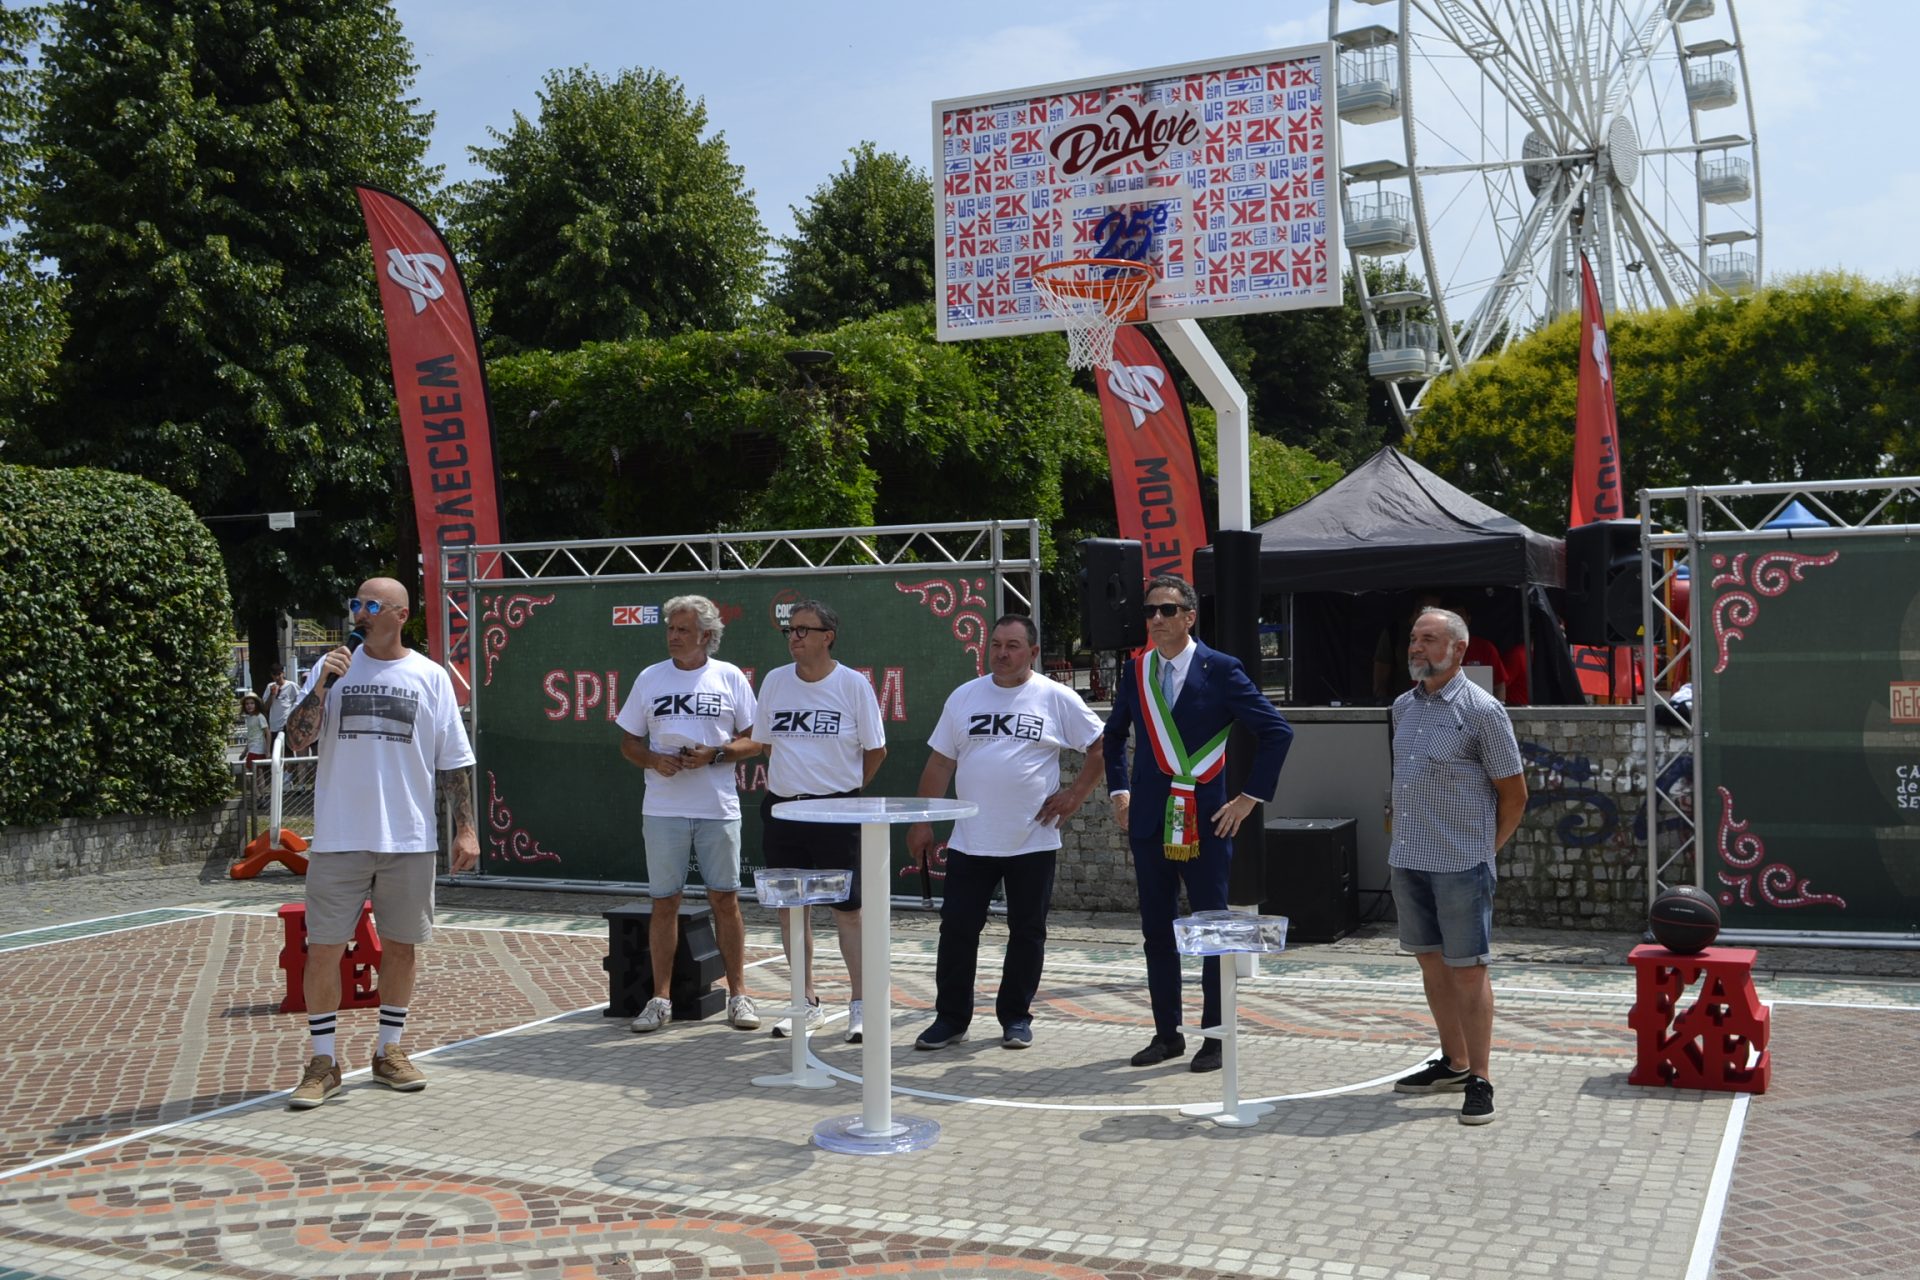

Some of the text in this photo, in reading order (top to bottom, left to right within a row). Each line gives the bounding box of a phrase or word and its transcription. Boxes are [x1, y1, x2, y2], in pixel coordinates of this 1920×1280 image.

[1011, 129, 1043, 154] 2K
[1050, 104, 1200, 176] DaMove
[1205, 124, 1224, 164] 2K
[1247, 117, 1282, 143] 2K
[1288, 113, 1308, 154] 2K
[975, 156, 991, 194] 2K
[996, 194, 1027, 218] 2K
[1270, 182, 1290, 222] 2K
[959, 220, 976, 258] 2K
[1032, 211, 1050, 249] 2K
[1209, 255, 1228, 295] 2K
[1251, 249, 1286, 274] 2K
[1292, 246, 1312, 287] 2K
[977, 280, 994, 317] 2K
[614, 607, 641, 624] 2K
[342, 685, 419, 700] COURT MLN
[654, 694, 695, 717] 2K
[771, 712, 814, 732] 2K
[969, 714, 1016, 735] 2K
[1897, 779, 1918, 794] de
